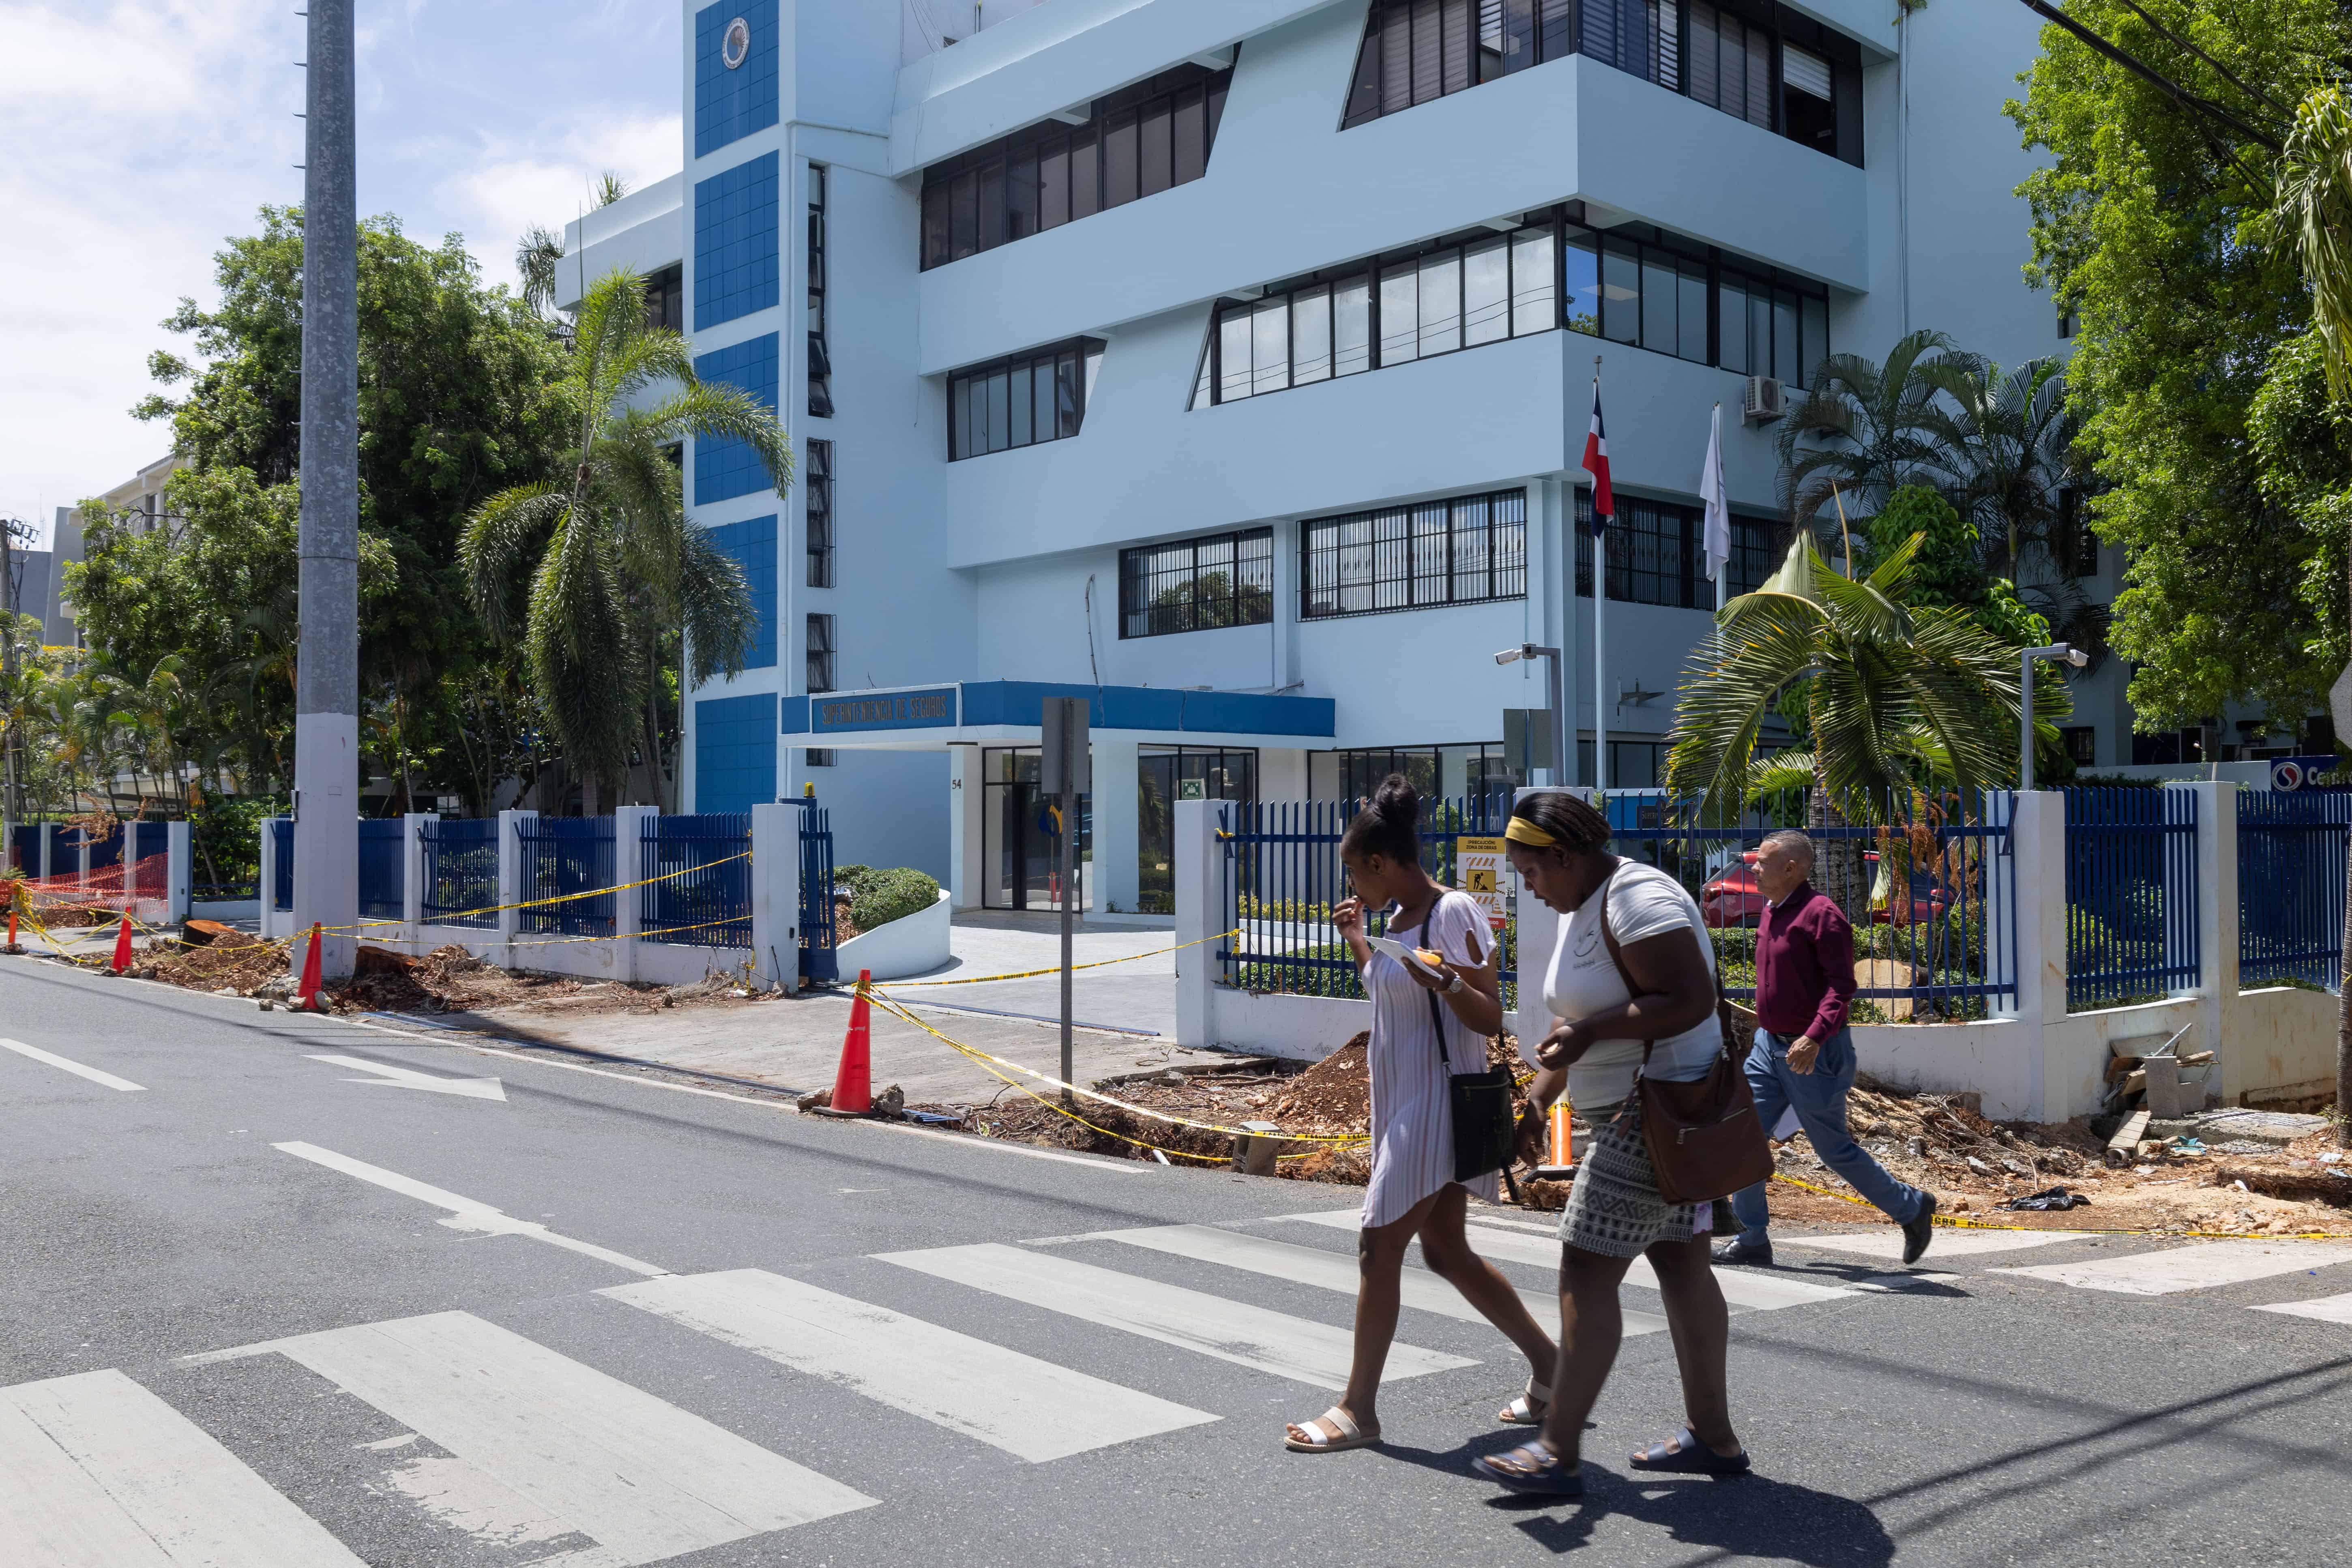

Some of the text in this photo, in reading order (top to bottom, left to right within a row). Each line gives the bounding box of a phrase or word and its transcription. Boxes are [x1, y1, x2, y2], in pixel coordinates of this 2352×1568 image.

[822, 695, 947, 725] SUPERINTENDENCIA DE SEGUROS
[952, 779, 961, 789] 54
